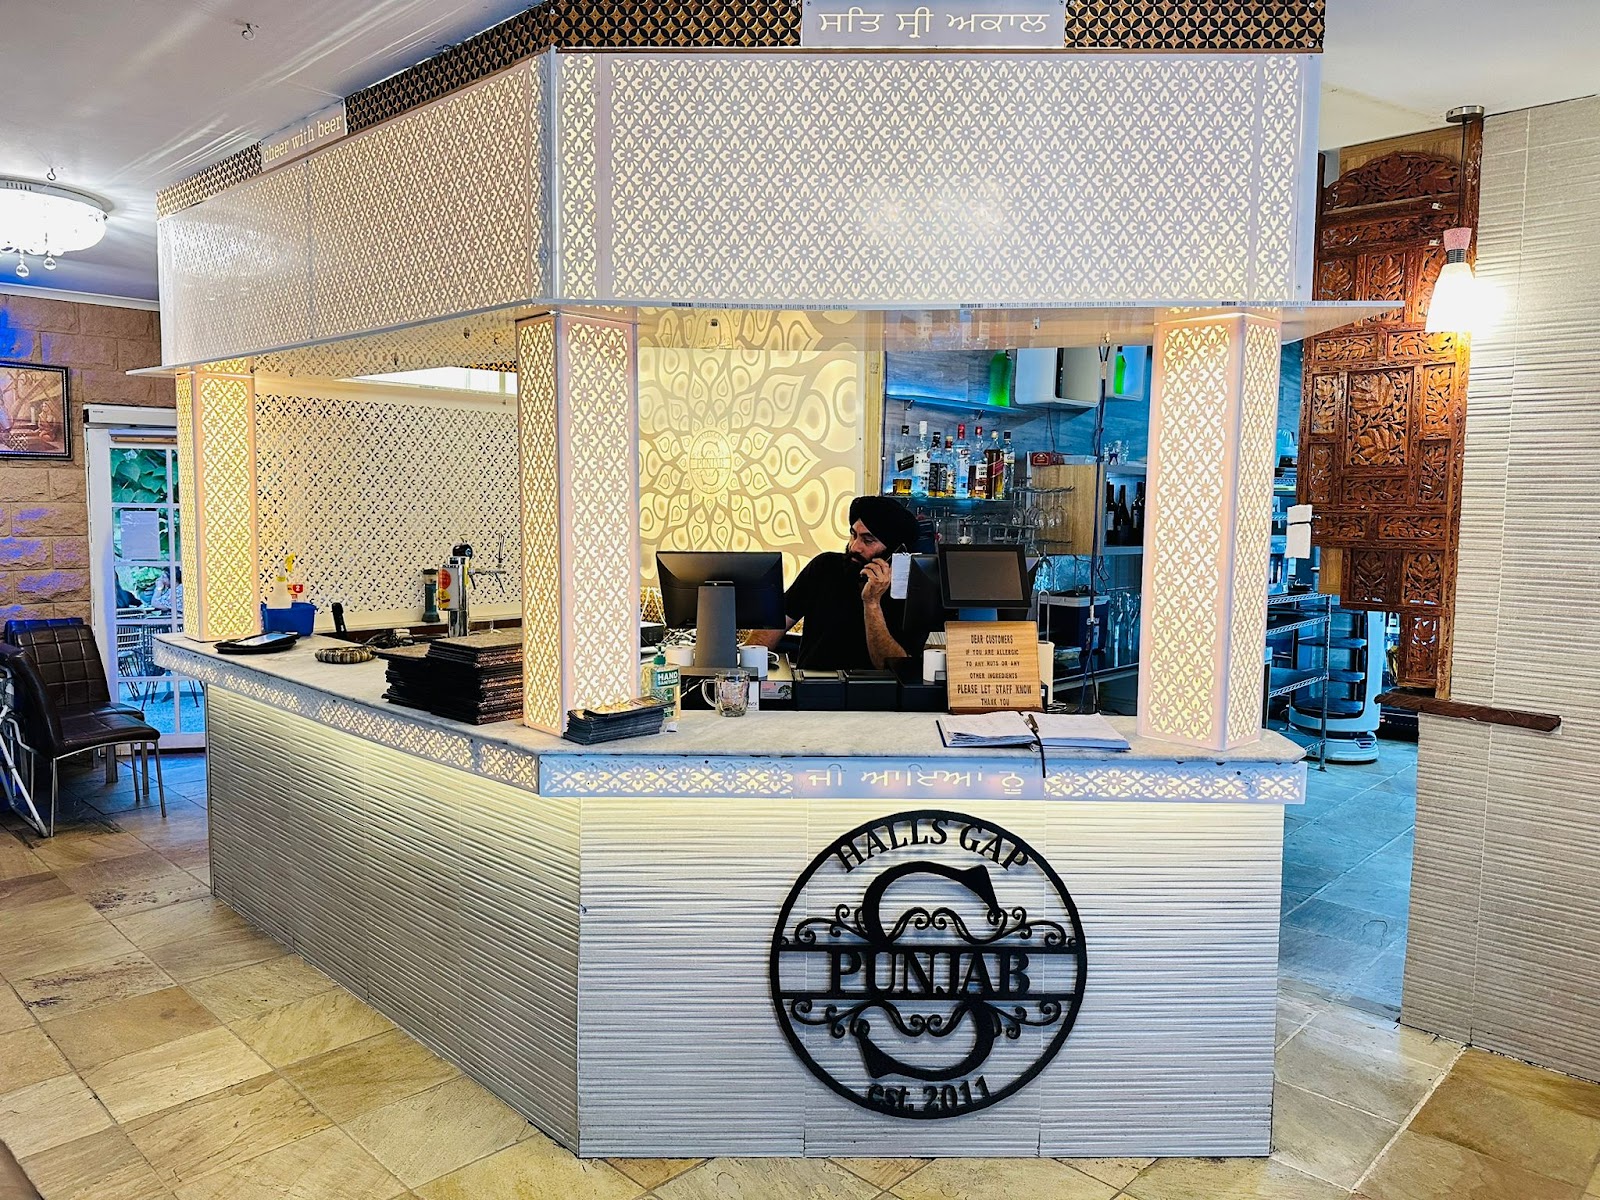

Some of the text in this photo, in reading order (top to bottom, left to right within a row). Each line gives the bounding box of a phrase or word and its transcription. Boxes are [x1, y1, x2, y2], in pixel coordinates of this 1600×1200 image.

[818, 6, 884, 33] ਸਤਿ
[946, 13, 1050, 33] ਅਕਾਲ
[263, 115, 342, 164] cheer with beer
[970, 634, 1014, 644] DEAR CUSTOMERS
[658, 671, 678, 681] HAND
[957, 684, 1032, 694] PLEASE LET STAFF KNOW
[980, 698, 1010, 706] THANK YOU
[805, 763, 846, 787] ਜੀ
[833, 818, 1029, 873] HALLS GAP
[827, 949, 1031, 996] PUNJAB
[867, 1075, 991, 1113] est. 2011
